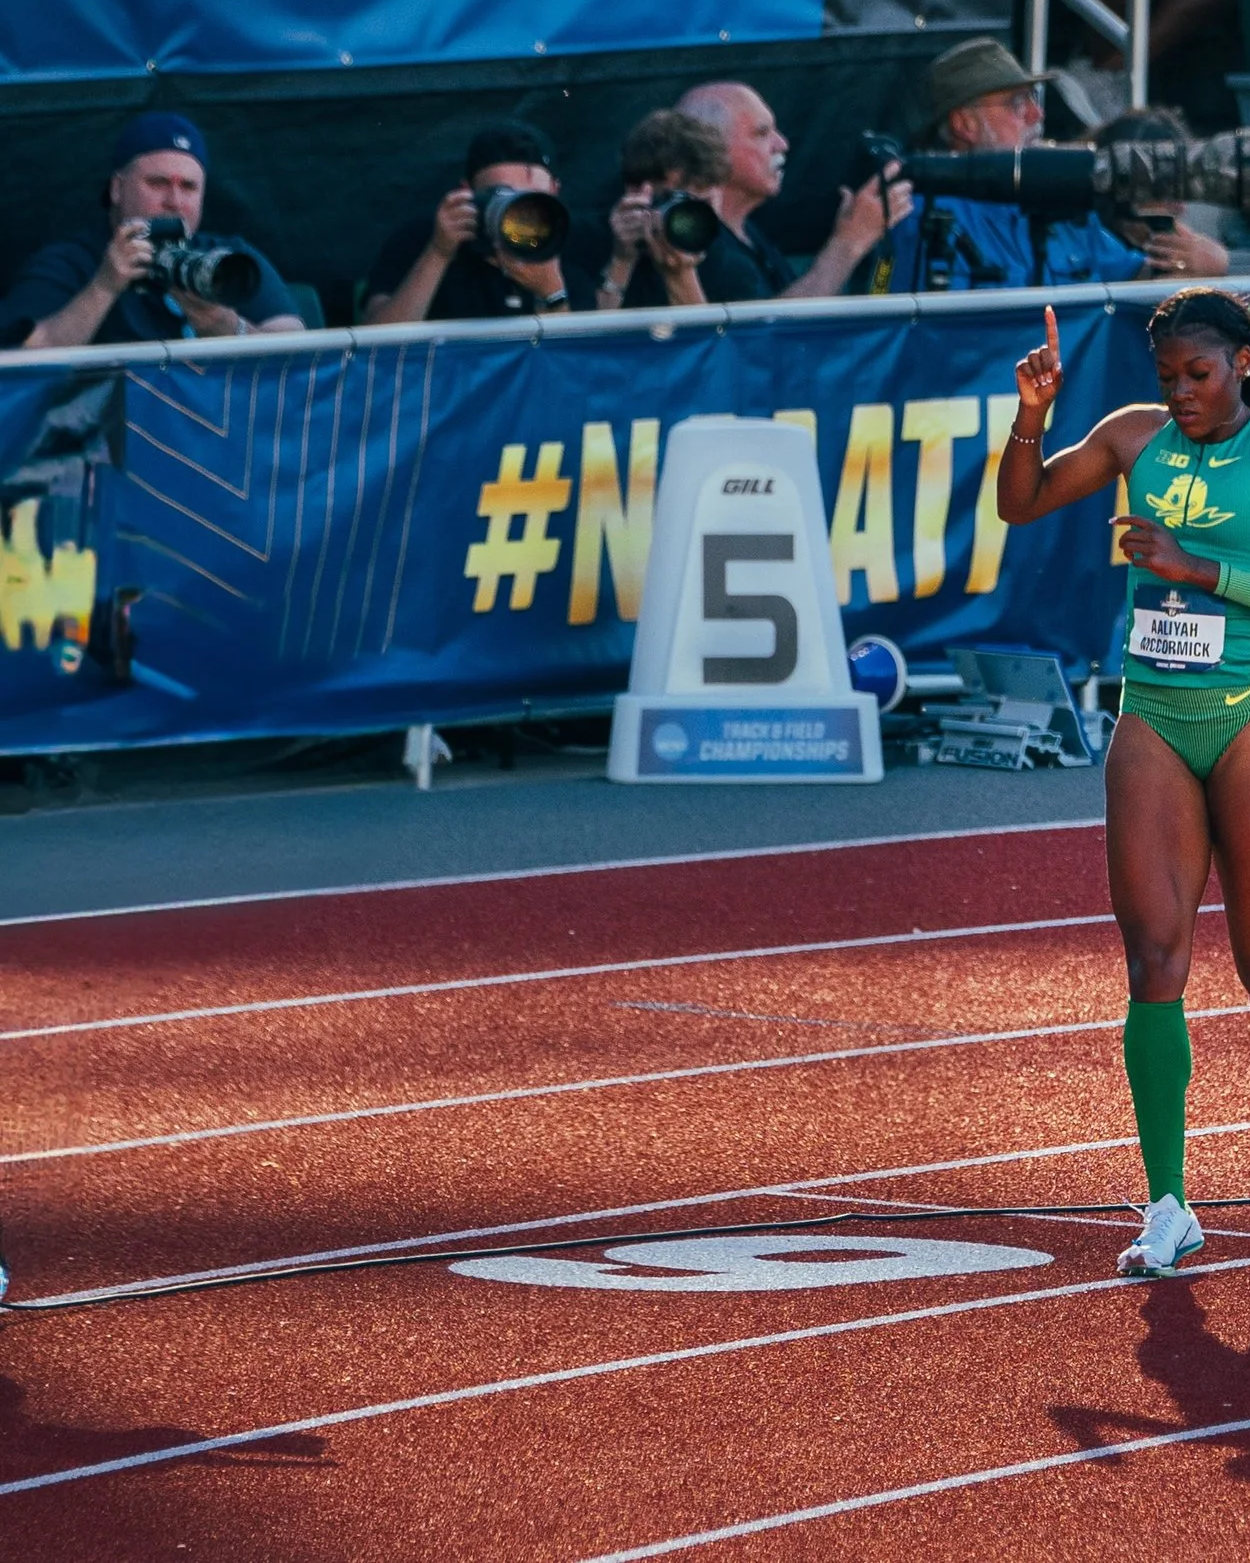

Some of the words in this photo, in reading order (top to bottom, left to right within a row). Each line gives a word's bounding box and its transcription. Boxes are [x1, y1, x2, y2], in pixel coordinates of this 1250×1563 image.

[722, 477, 776, 496] GILL
[463, 394, 1053, 626] #NAT
[703, 534, 798, 685] 5
[1151, 619, 1198, 638] AALIYAH
[785, 721, 826, 739] FIELD
[699, 739, 851, 762] CHAMPIONSHIPS
